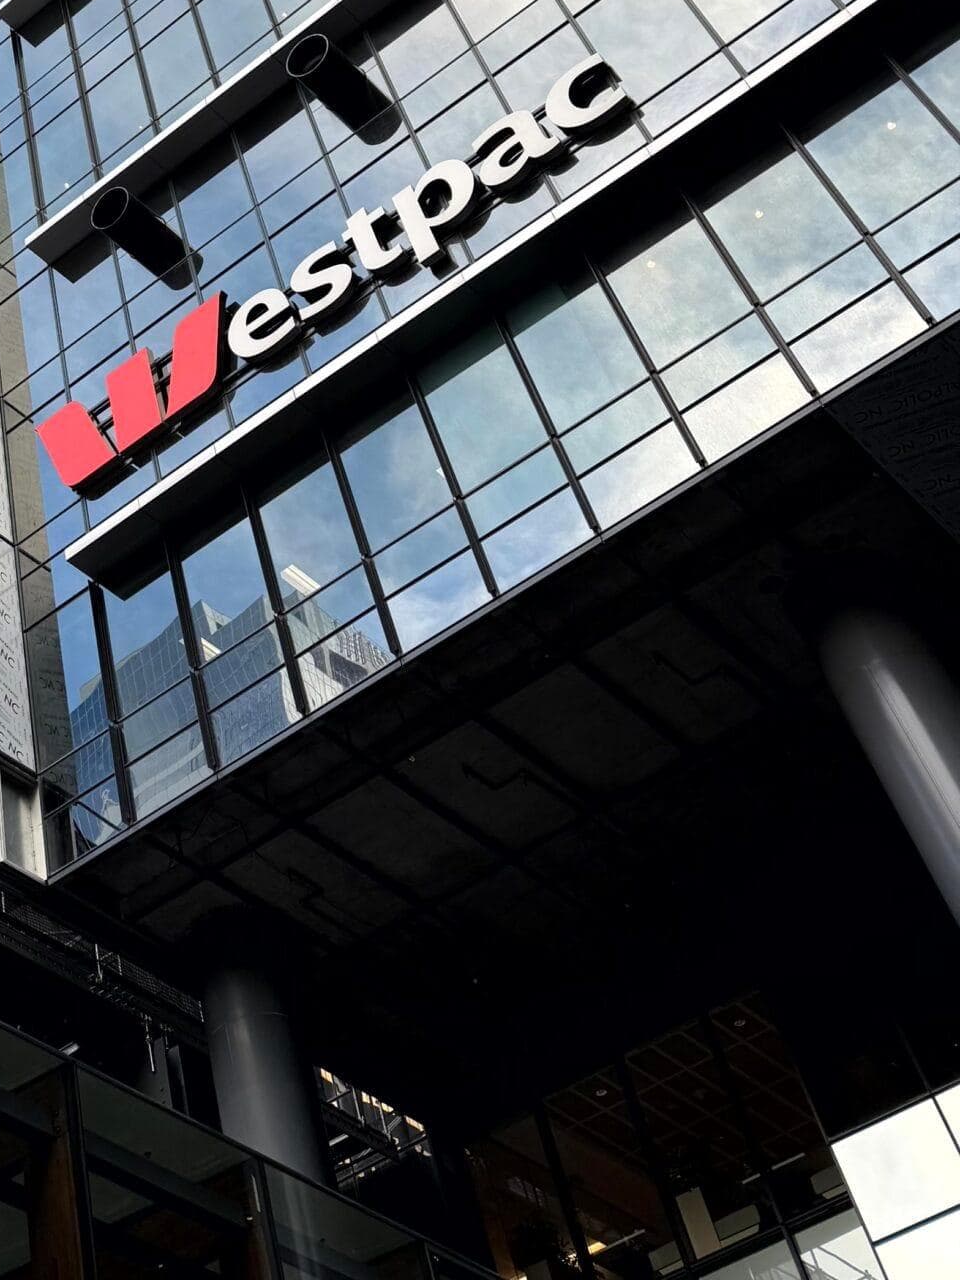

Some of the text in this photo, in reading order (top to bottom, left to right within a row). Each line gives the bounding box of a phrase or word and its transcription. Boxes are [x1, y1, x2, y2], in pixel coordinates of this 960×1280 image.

[36, 52, 628, 487] Westpac
[0, 649, 15, 669] NC
[4, 695, 20, 714] NC
[8, 743, 24, 762] NC
